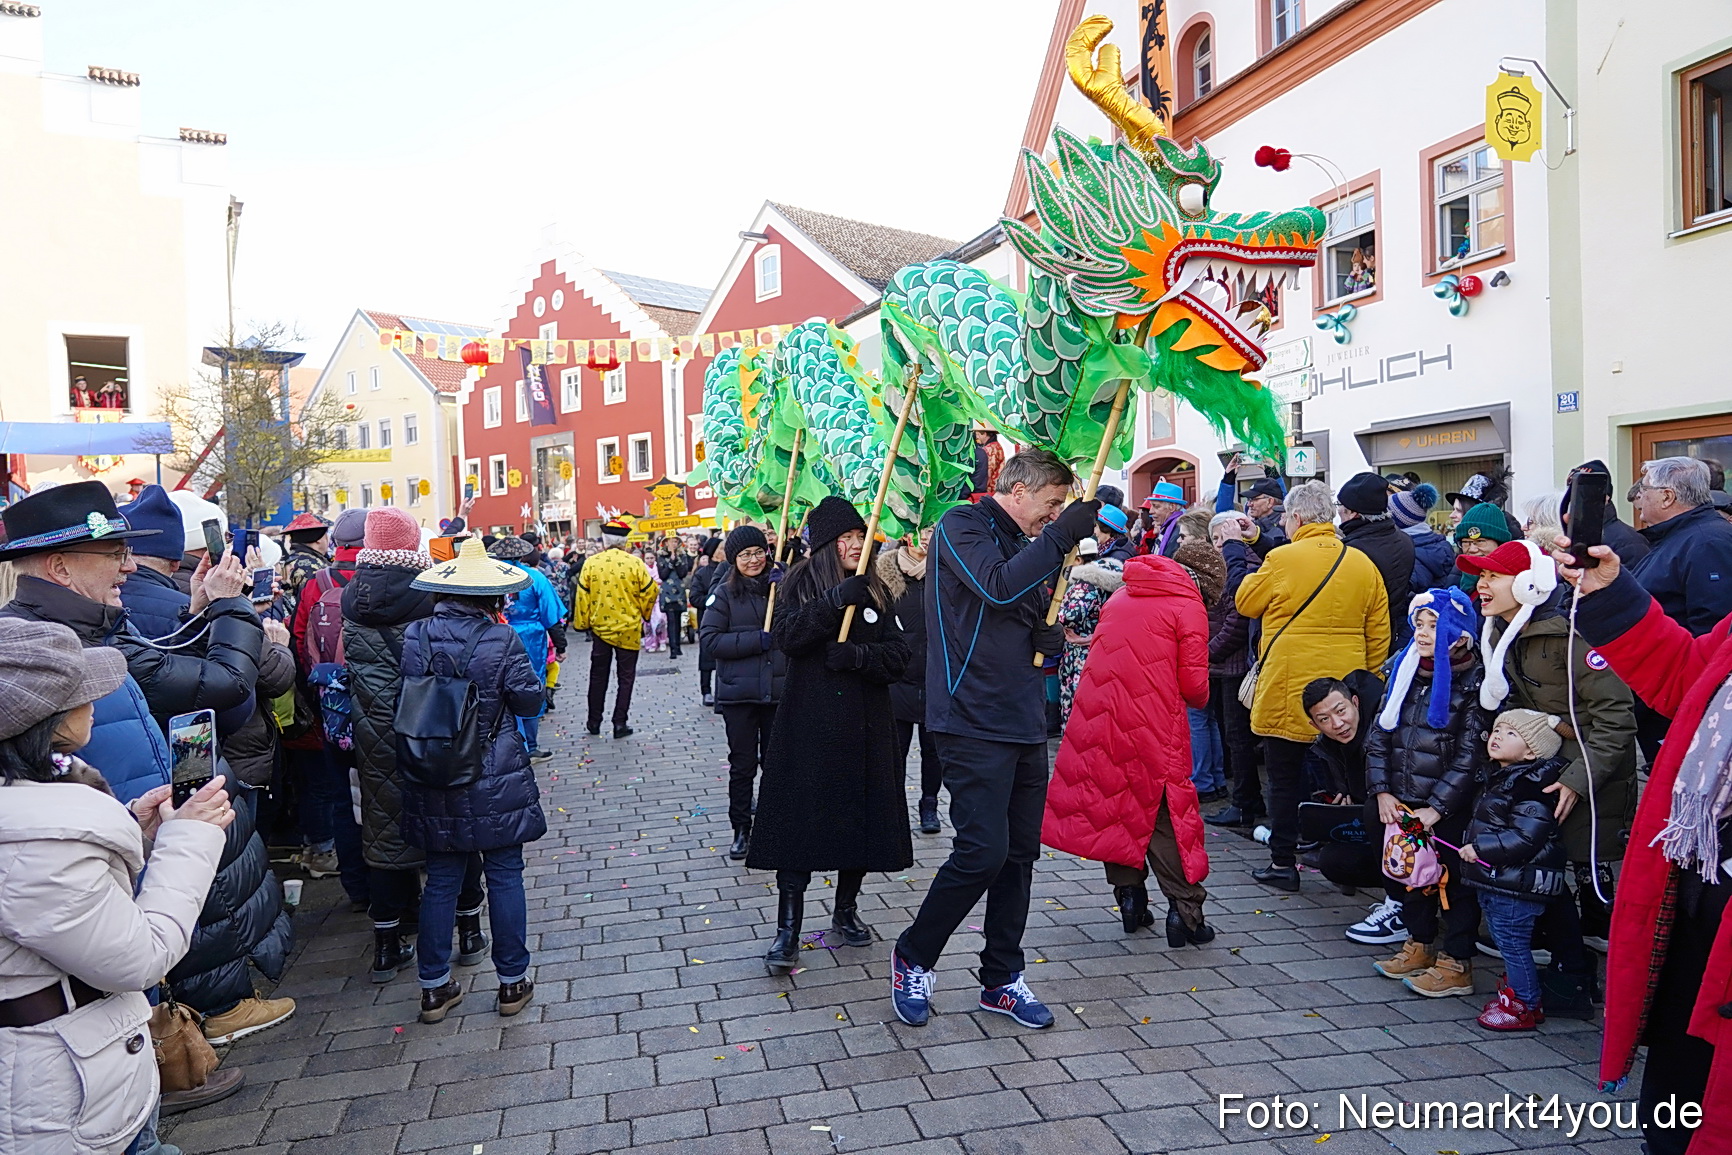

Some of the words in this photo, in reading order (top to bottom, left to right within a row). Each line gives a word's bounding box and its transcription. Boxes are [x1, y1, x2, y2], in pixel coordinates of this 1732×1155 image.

[1326, 345, 1370, 366] JUWELIER
[1560, 393, 1576, 406] 20
[1416, 428, 1477, 448] UHREN
[650, 519, 689, 529] Kaisergarde
[998, 993, 1018, 1012] N
